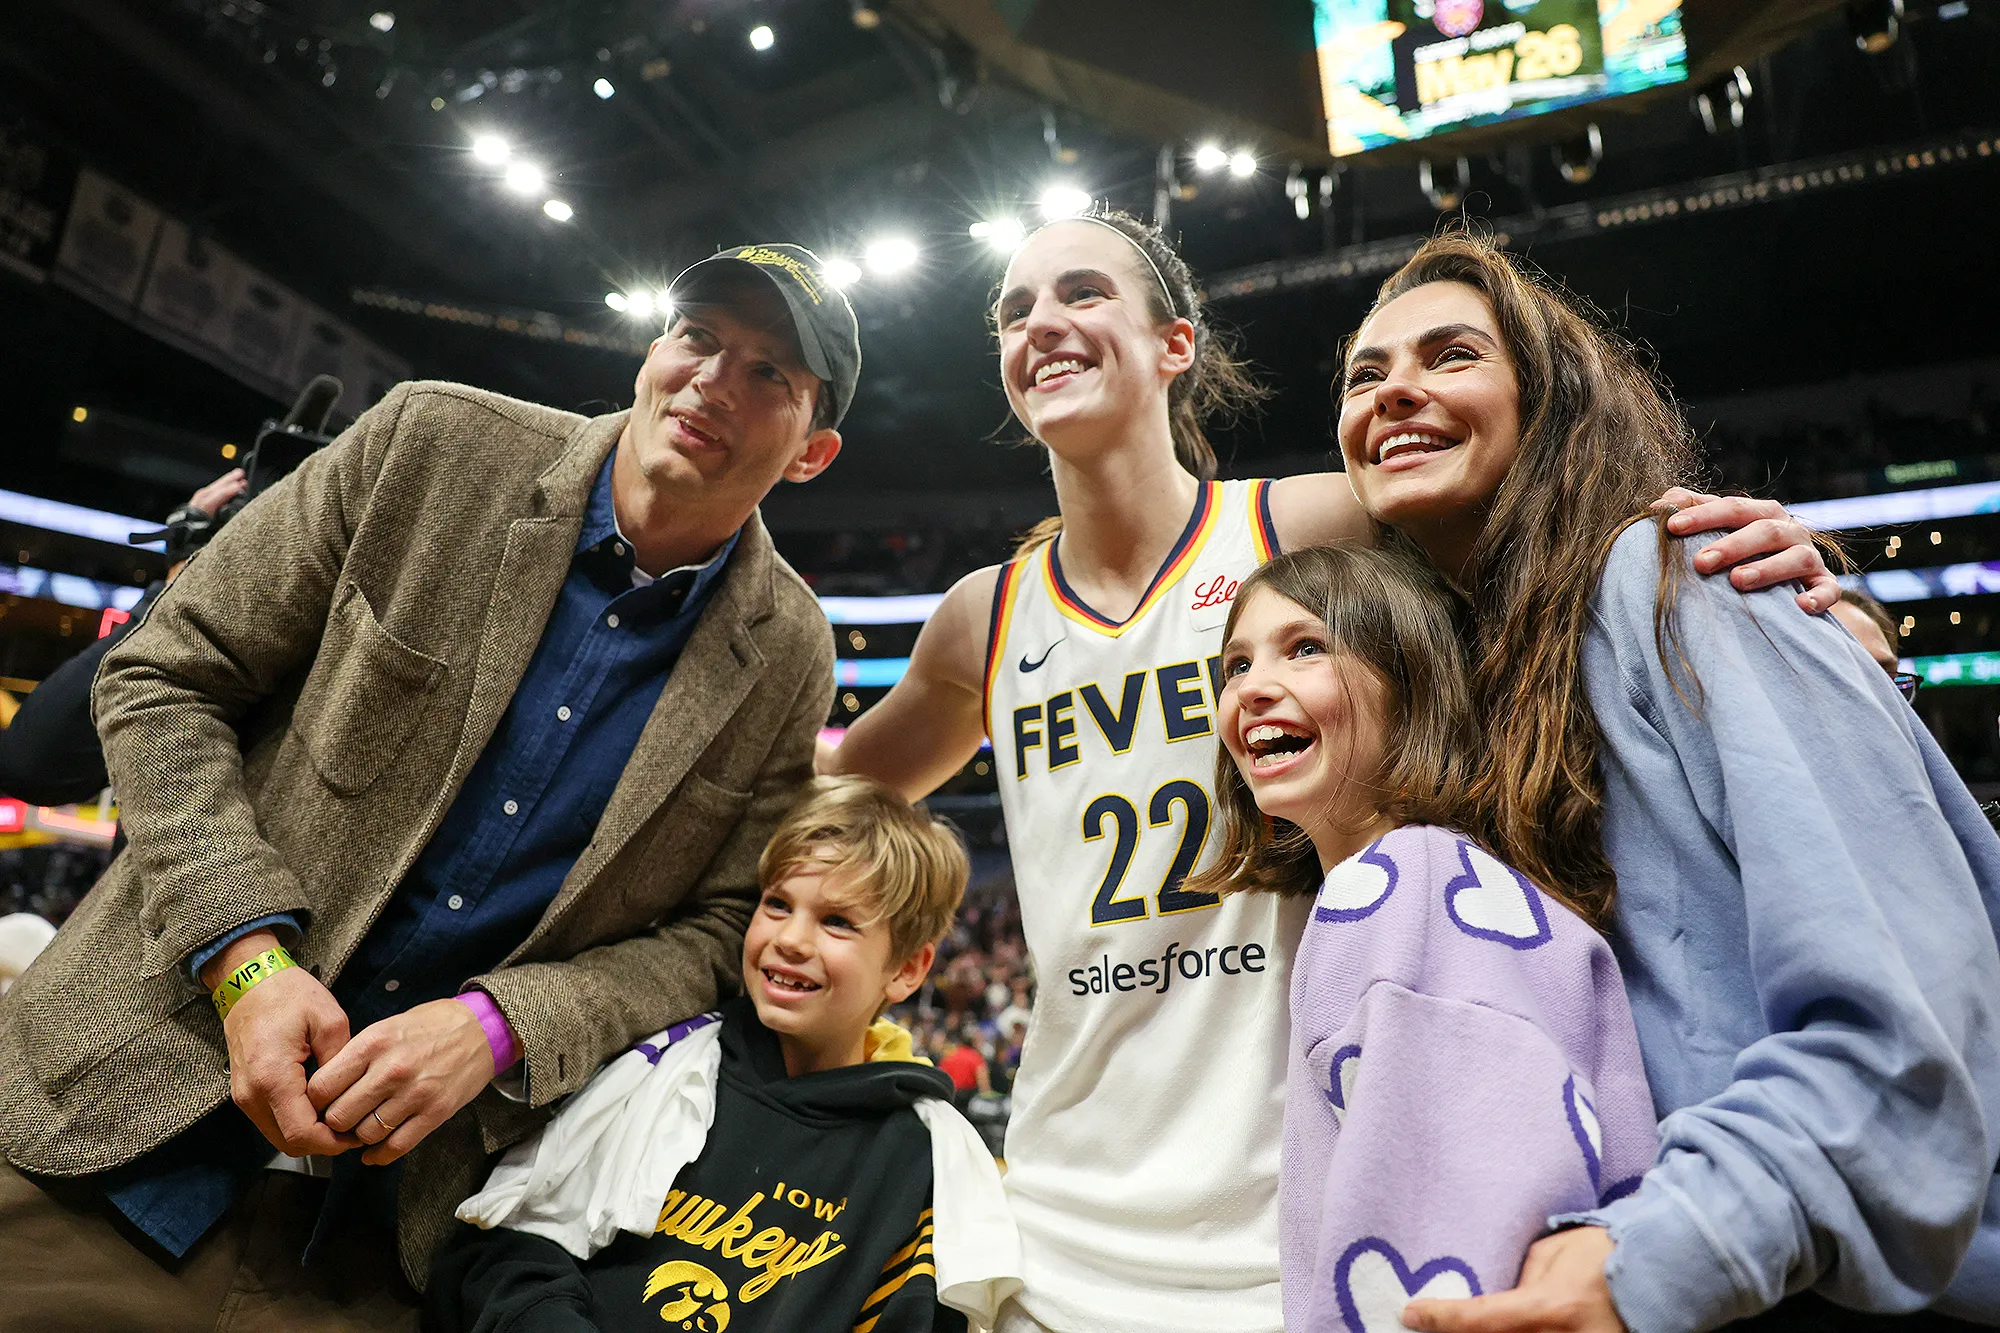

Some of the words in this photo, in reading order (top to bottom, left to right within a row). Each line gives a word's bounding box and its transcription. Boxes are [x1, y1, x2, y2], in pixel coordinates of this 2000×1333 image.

[1514, 24, 1583, 81] 26
[1191, 575, 1244, 610] Lil
[1082, 777, 1223, 928] 22
[228, 963, 260, 990] VIP
[1068, 942, 1266, 996] salesforce
[772, 1181, 849, 1223] IOW
